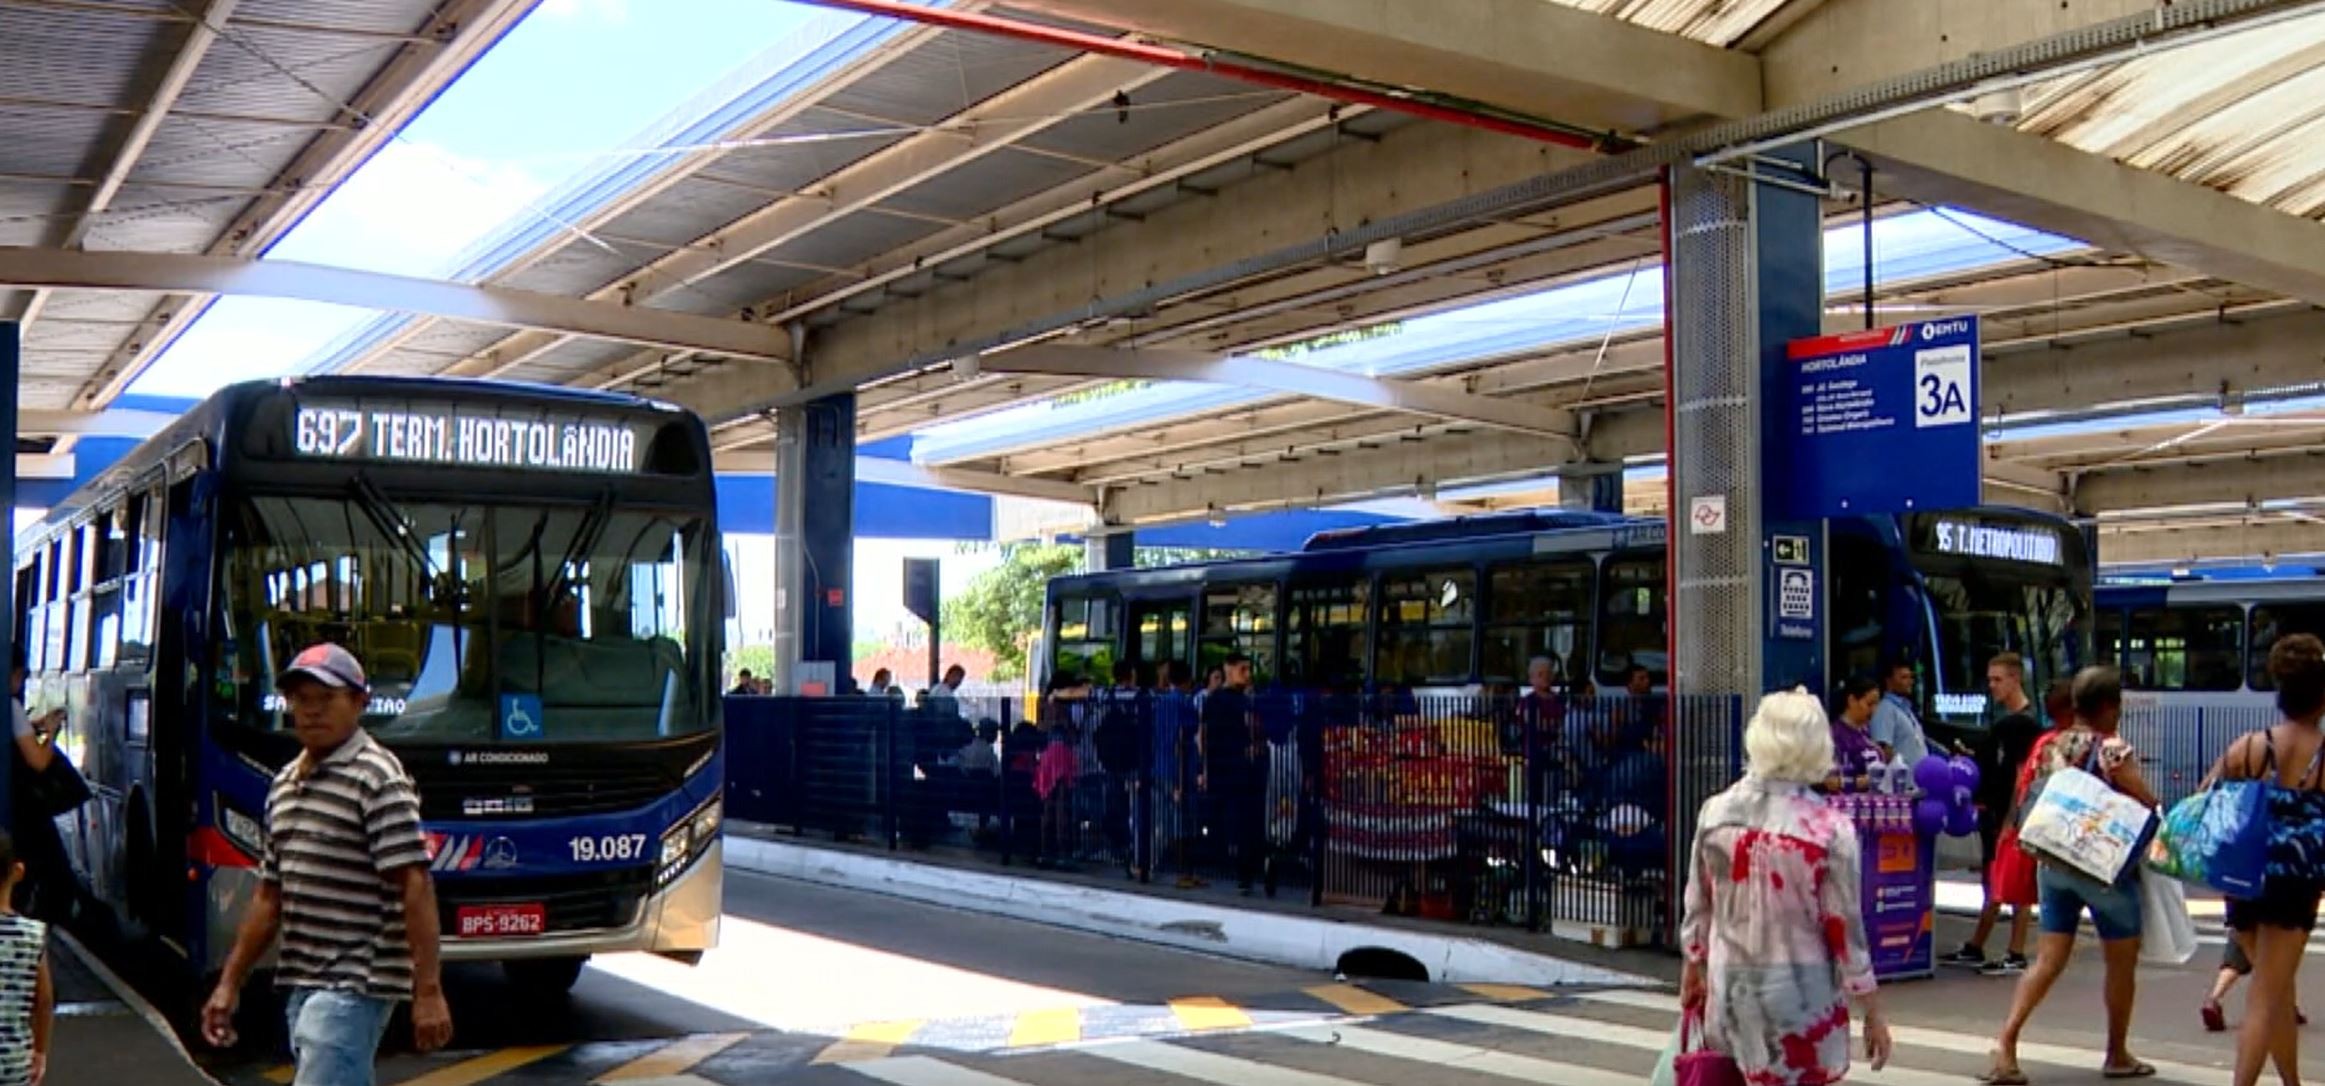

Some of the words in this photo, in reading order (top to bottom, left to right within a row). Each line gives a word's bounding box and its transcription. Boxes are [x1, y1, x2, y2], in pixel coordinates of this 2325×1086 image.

[1935, 320, 1968, 336] EMTU
[1920, 373, 1966, 417] 3A
[297, 409, 363, 454] 697
[464, 752, 478, 763] AR
[480, 752, 550, 763] CONDICIONADO
[569, 834, 647, 860] 19.087
